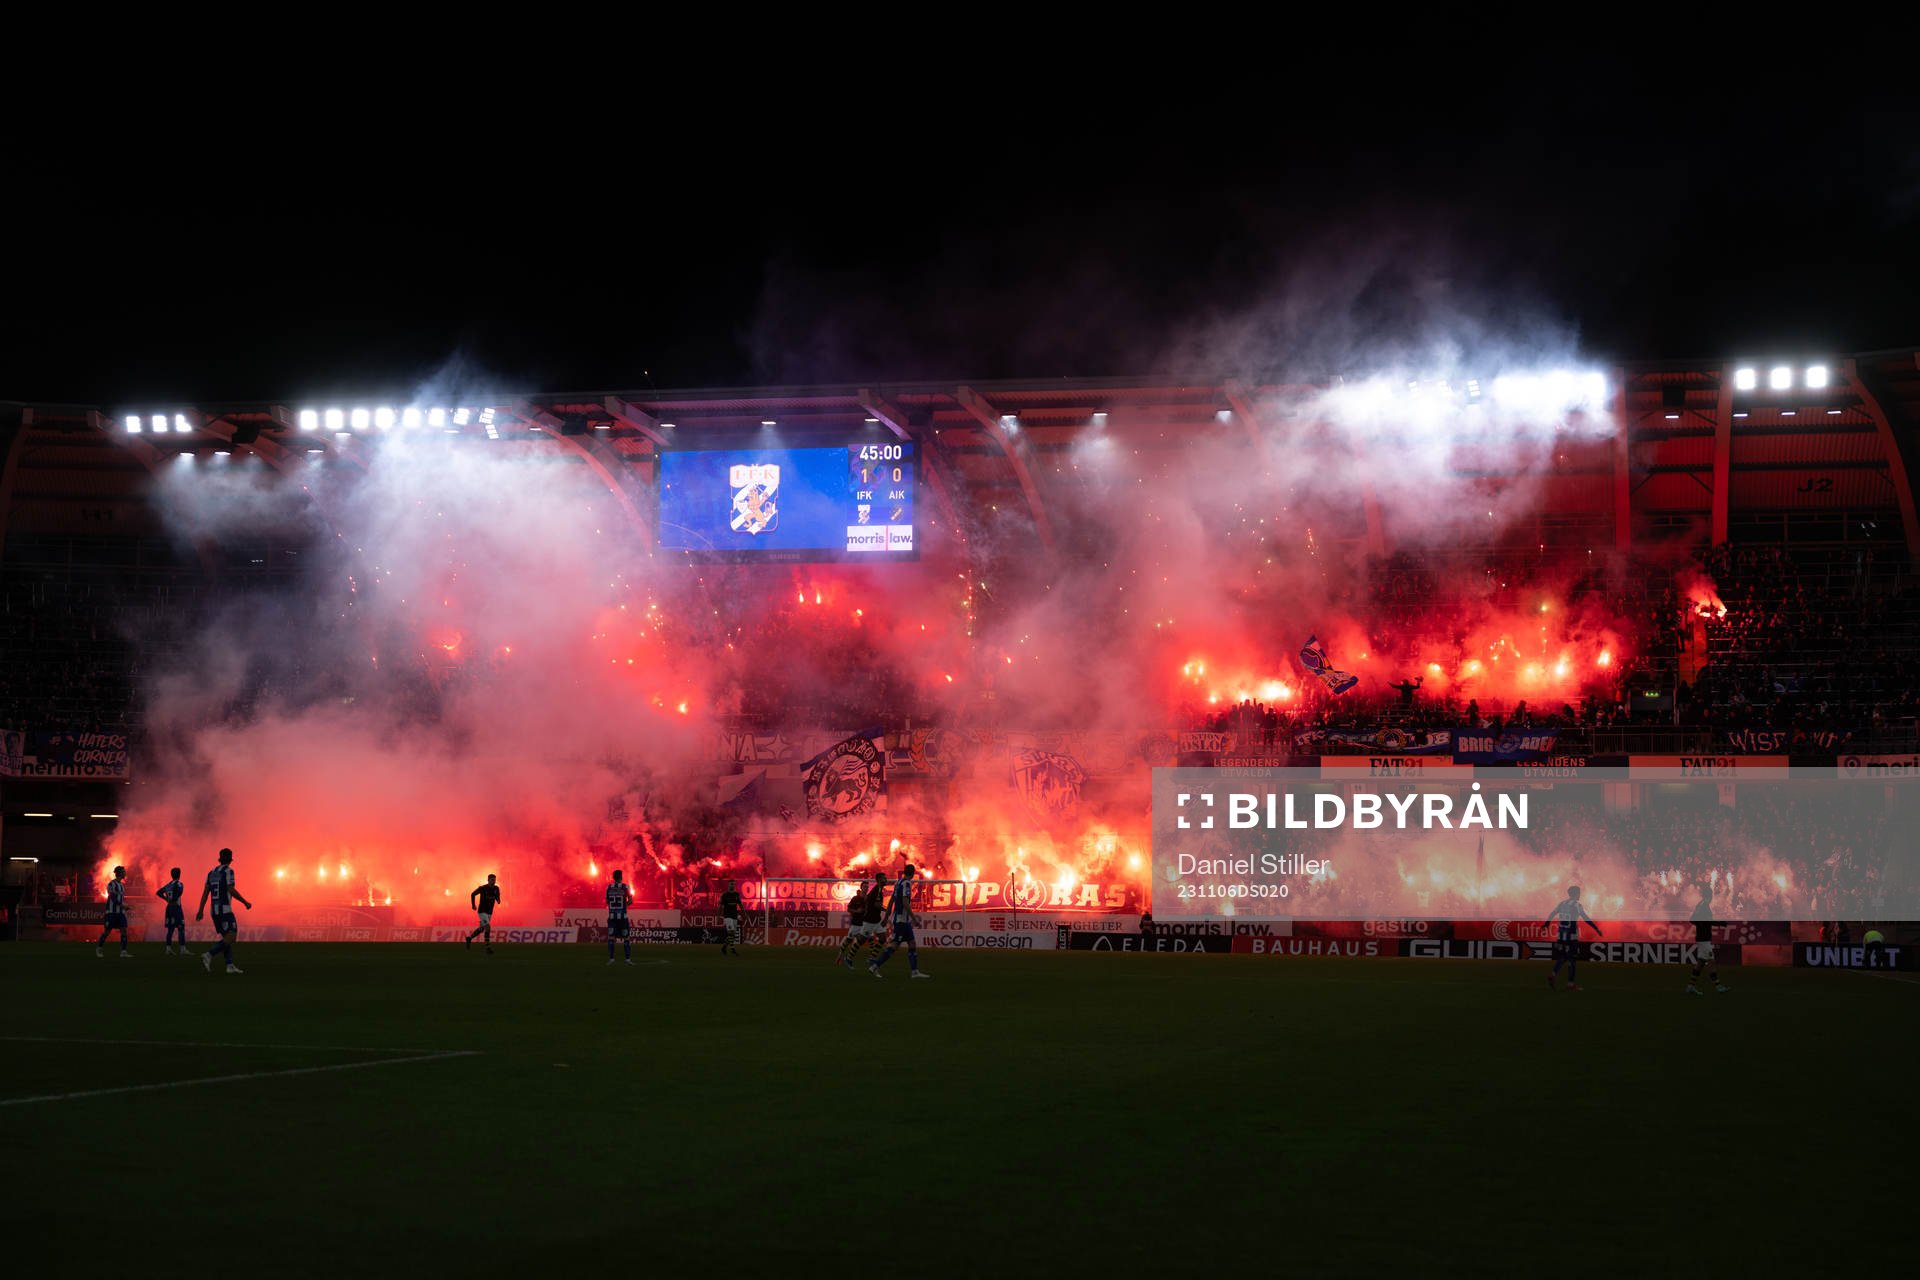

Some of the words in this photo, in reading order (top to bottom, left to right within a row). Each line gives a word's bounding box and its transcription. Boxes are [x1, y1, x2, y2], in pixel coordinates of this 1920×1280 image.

[859, 445, 902, 460] 45:00
[861, 467, 868, 483] 1
[893, 467, 902, 482] 0
[857, 491, 873, 500] IFK
[889, 490, 905, 500] AIK
[847, 533, 885, 544] morris
[889, 532, 913, 544] law.
[78, 732, 127, 750] HATERS
[1458, 736, 1494, 753] BRIG
[73, 749, 127, 765] CORNER
[1213, 757, 1281, 767] LEGENDENS
[1220, 768, 1272, 777] UTVALDA
[1369, 758, 1425, 777] FAT21
[1524, 768, 1578, 777] UTVALDA
[1680, 757, 1738, 777] FAT21
[609, 895, 624, 909] 23
[933, 882, 1000, 907] SUP
[1048, 884, 1126, 907] RAS
[45, 908, 78, 920] Gamla
[555, 917, 599, 928] RASTA
[628, 918, 662, 928] ASTA
[1153, 920, 1221, 936] morris
[1231, 921, 1274, 936] law.
[1363, 919, 1428, 936] gastro
[629, 928, 677, 939] öteborgs
[1123, 937, 1207, 953] ELEDA
[1253, 939, 1378, 956] BAUHAUS
[1589, 942, 1698, 964] SERNEK
[1806, 946, 1900, 967] UNIBT
